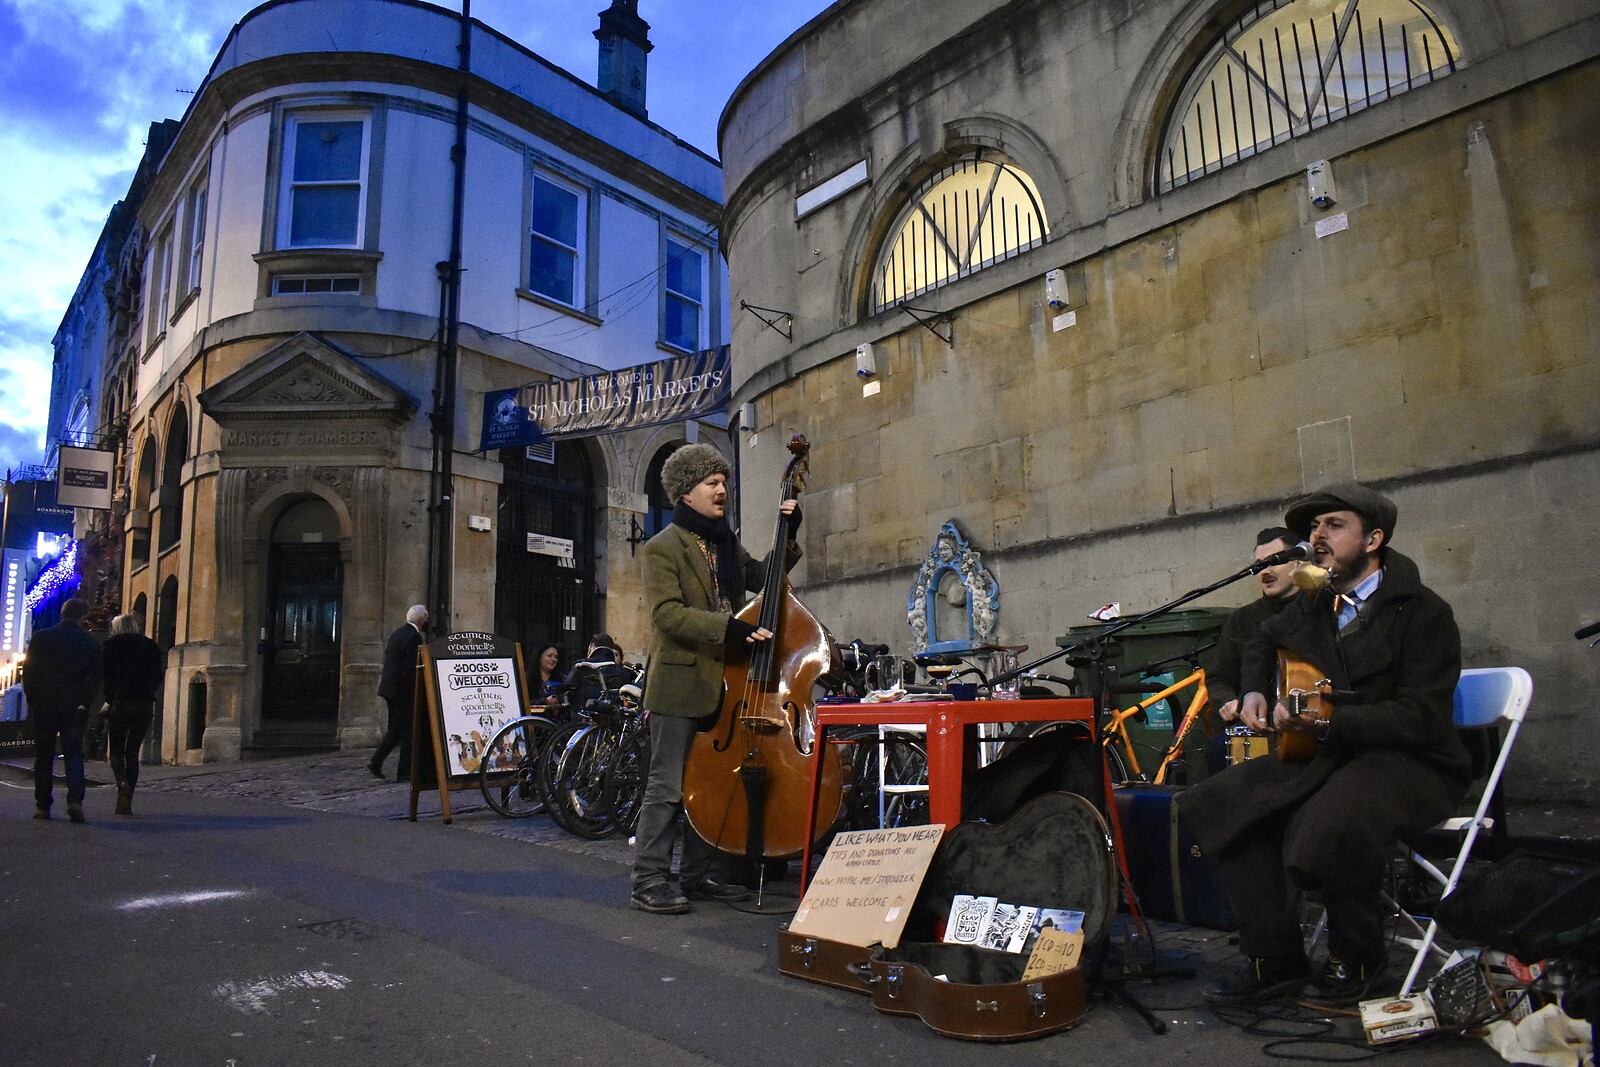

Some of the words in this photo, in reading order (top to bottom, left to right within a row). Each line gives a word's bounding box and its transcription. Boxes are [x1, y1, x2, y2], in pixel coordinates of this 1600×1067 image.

[589, 372, 641, 392] WELCOME
[642, 372, 653, 382] to
[528, 404, 547, 421] ST
[550, 390, 631, 418] NICHOLAS
[636, 370, 723, 404] MARKETS
[227, 431, 289, 446] MARKET
[298, 431, 378, 446] CHAMBERS
[462, 663, 490, 673] DOGS
[454, 675, 504, 686] WELCOME
[836, 833, 866, 847] LIKE
[866, 831, 895, 844] WHAT
[895, 831, 910, 843] YOU
[912, 828, 942, 843] HEAR?
[831, 850, 847, 860] TIPS
[848, 848, 865, 859] AND
[867, 847, 901, 858] DONATIONS
[904, 847, 918, 855] ARE
[811, 897, 839, 910] CARDS
[846, 896, 888, 907] WELCOME
